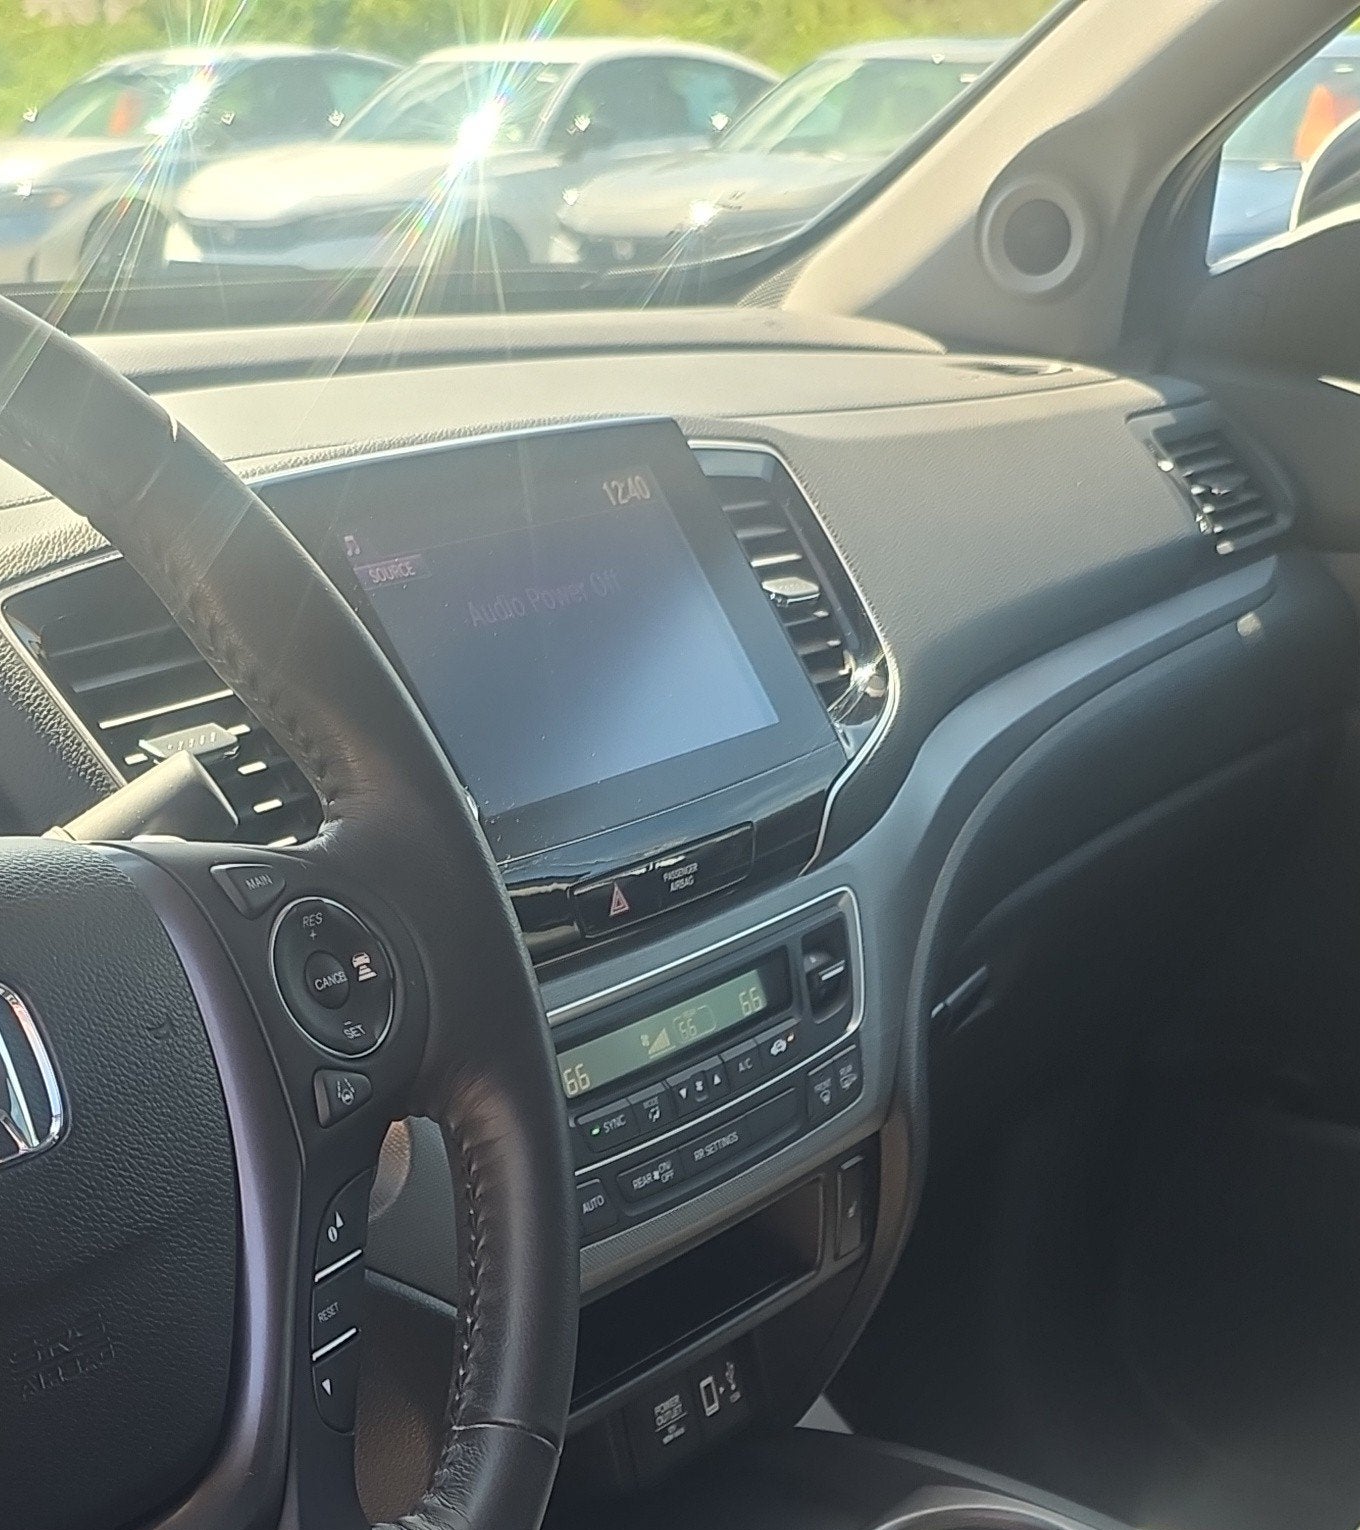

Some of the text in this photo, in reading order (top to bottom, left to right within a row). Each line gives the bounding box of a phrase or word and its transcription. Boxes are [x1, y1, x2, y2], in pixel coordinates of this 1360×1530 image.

[368, 561, 416, 584] SOURCE
[468, 567, 623, 628] Audio Power Off
[245, 873, 273, 891] MAIN
[302, 912, 323, 928] RES
[739, 986, 763, 1017] 66
[343, 1023, 366, 1040] SET
[563, 1063, 591, 1095] 66
[603, 1114, 626, 1133] SYNC
[705, 1131, 739, 1156] SETTINGS
[632, 1160, 672, 1190] REAR ON
[660, 1170, 674, 1183] OFF
[582, 1194, 605, 1214] AUTO
[317, 1302, 340, 1323] RESET
